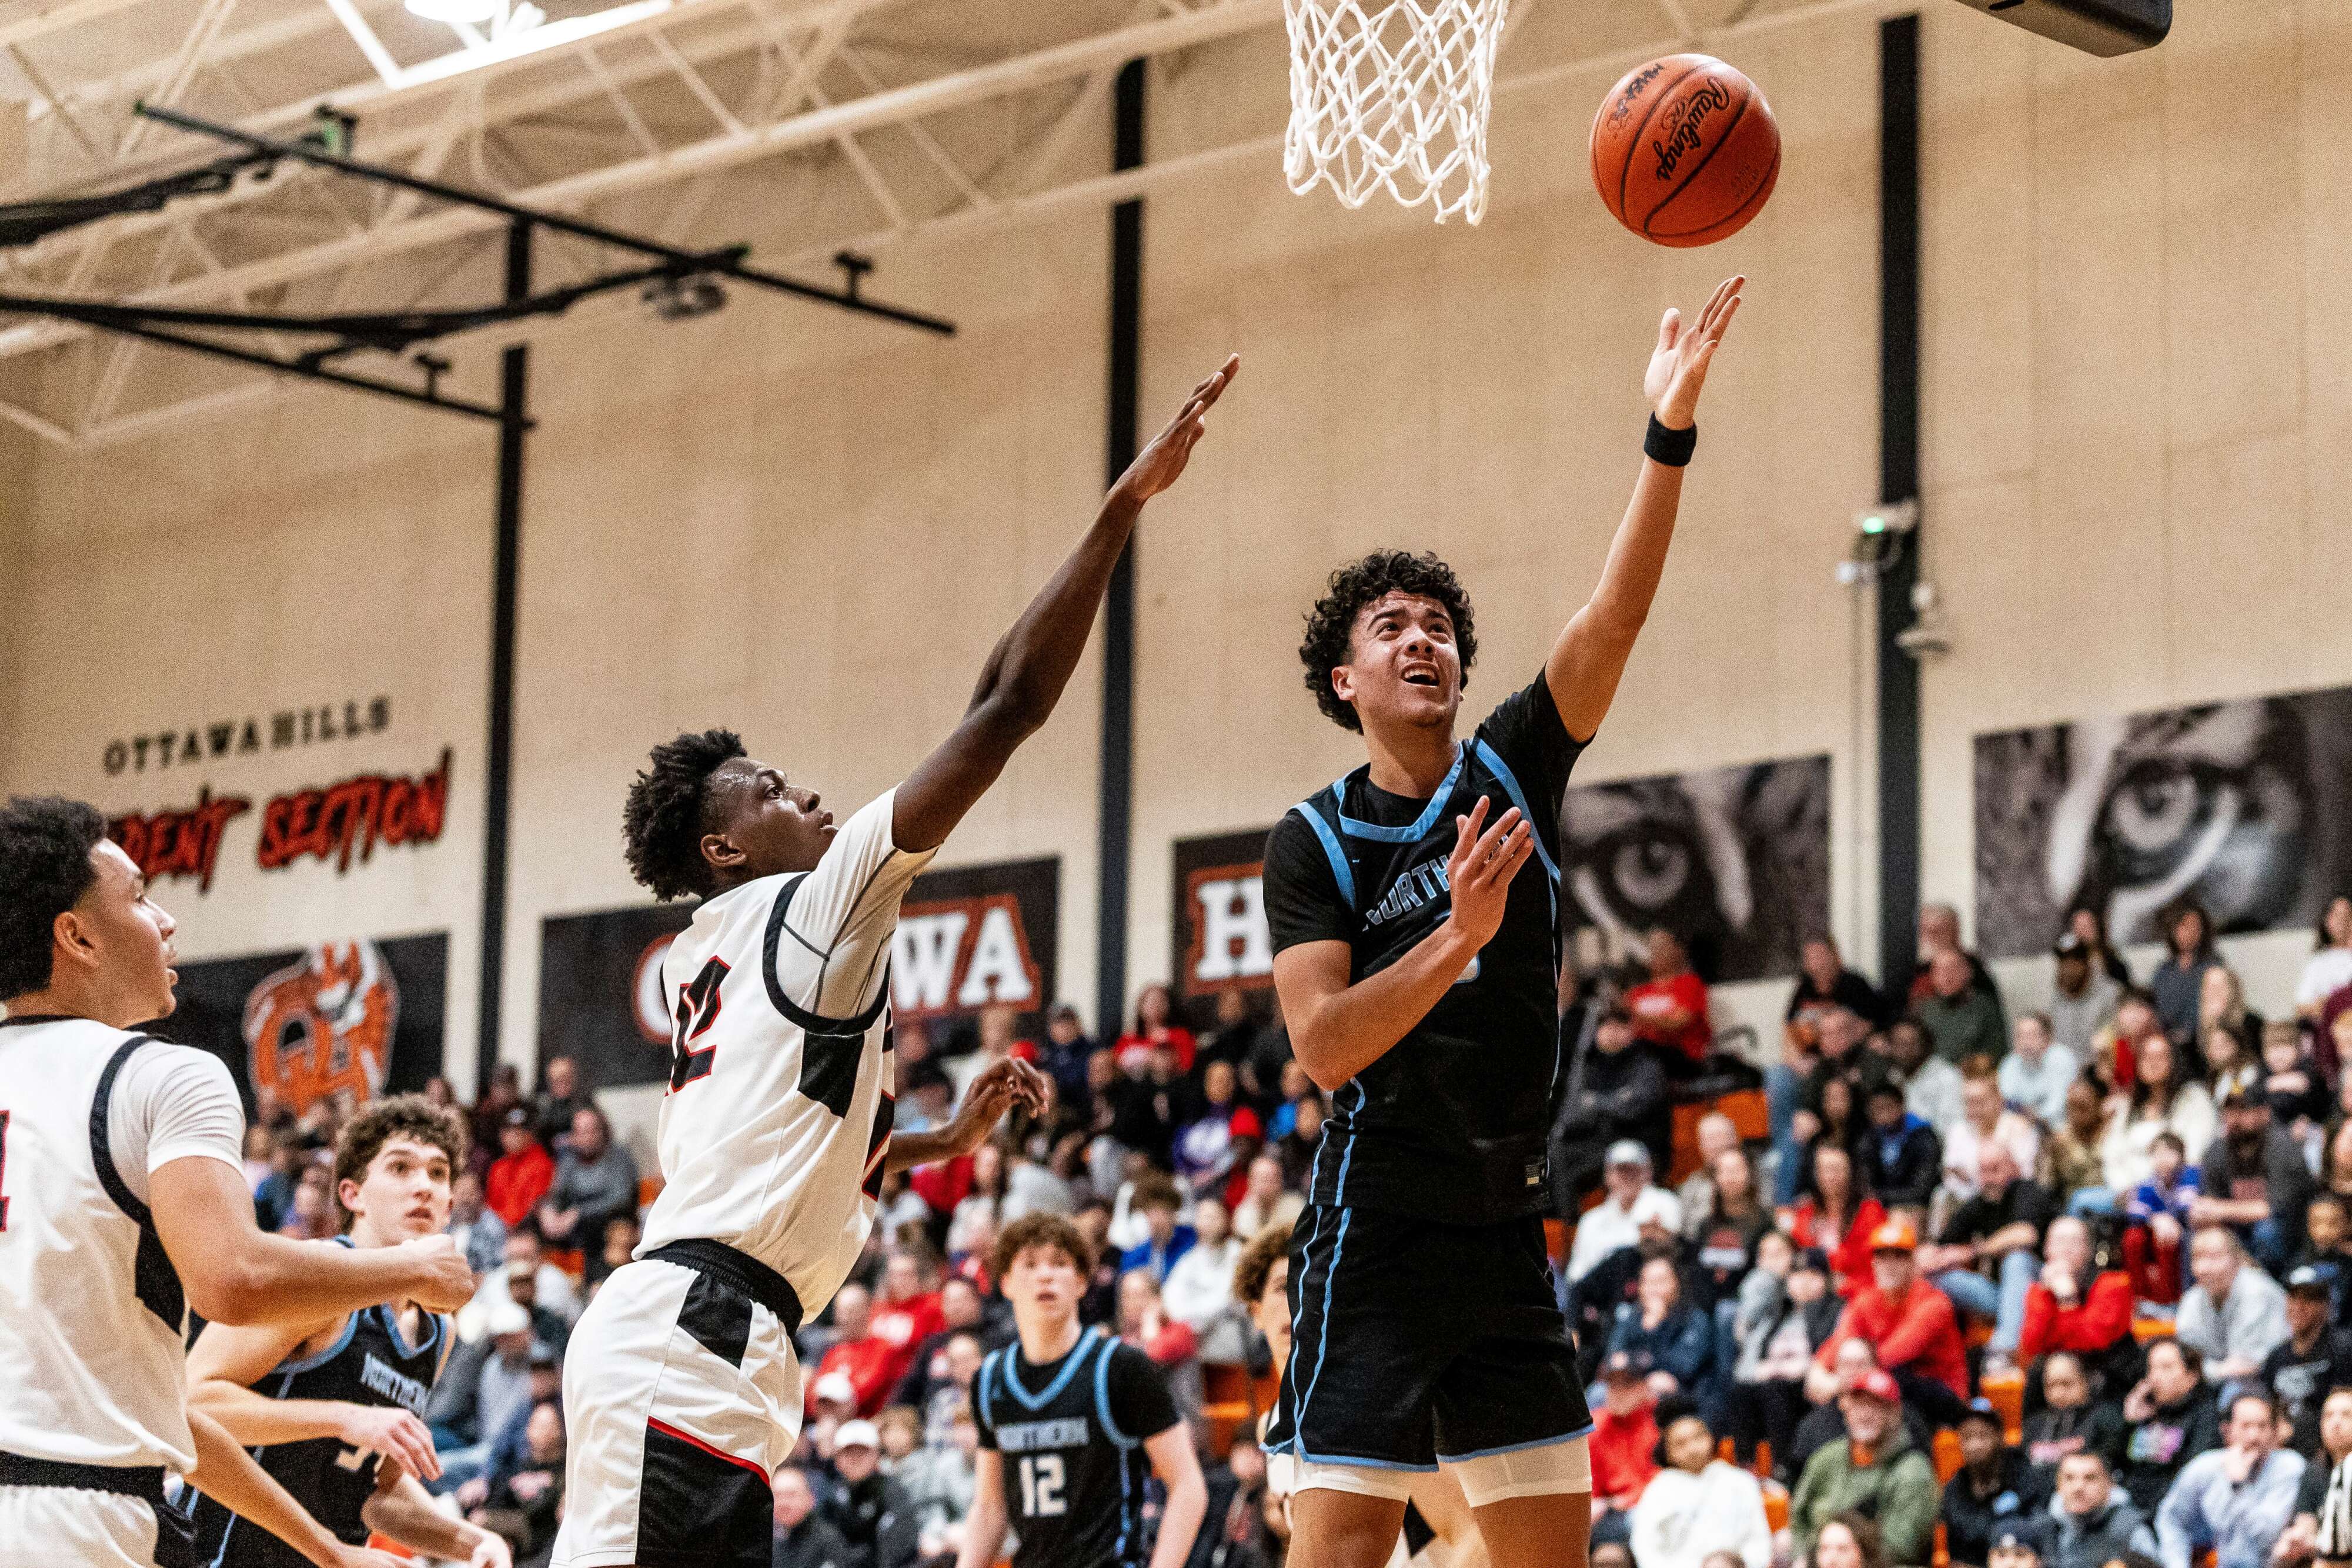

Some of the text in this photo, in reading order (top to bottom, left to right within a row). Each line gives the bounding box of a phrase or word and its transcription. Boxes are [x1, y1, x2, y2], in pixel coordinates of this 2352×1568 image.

[1653, 76, 1730, 182] Rawlings
[102, 695, 389, 776] OTTAWA HILLS
[1018, 1453, 1068, 1517] 12
